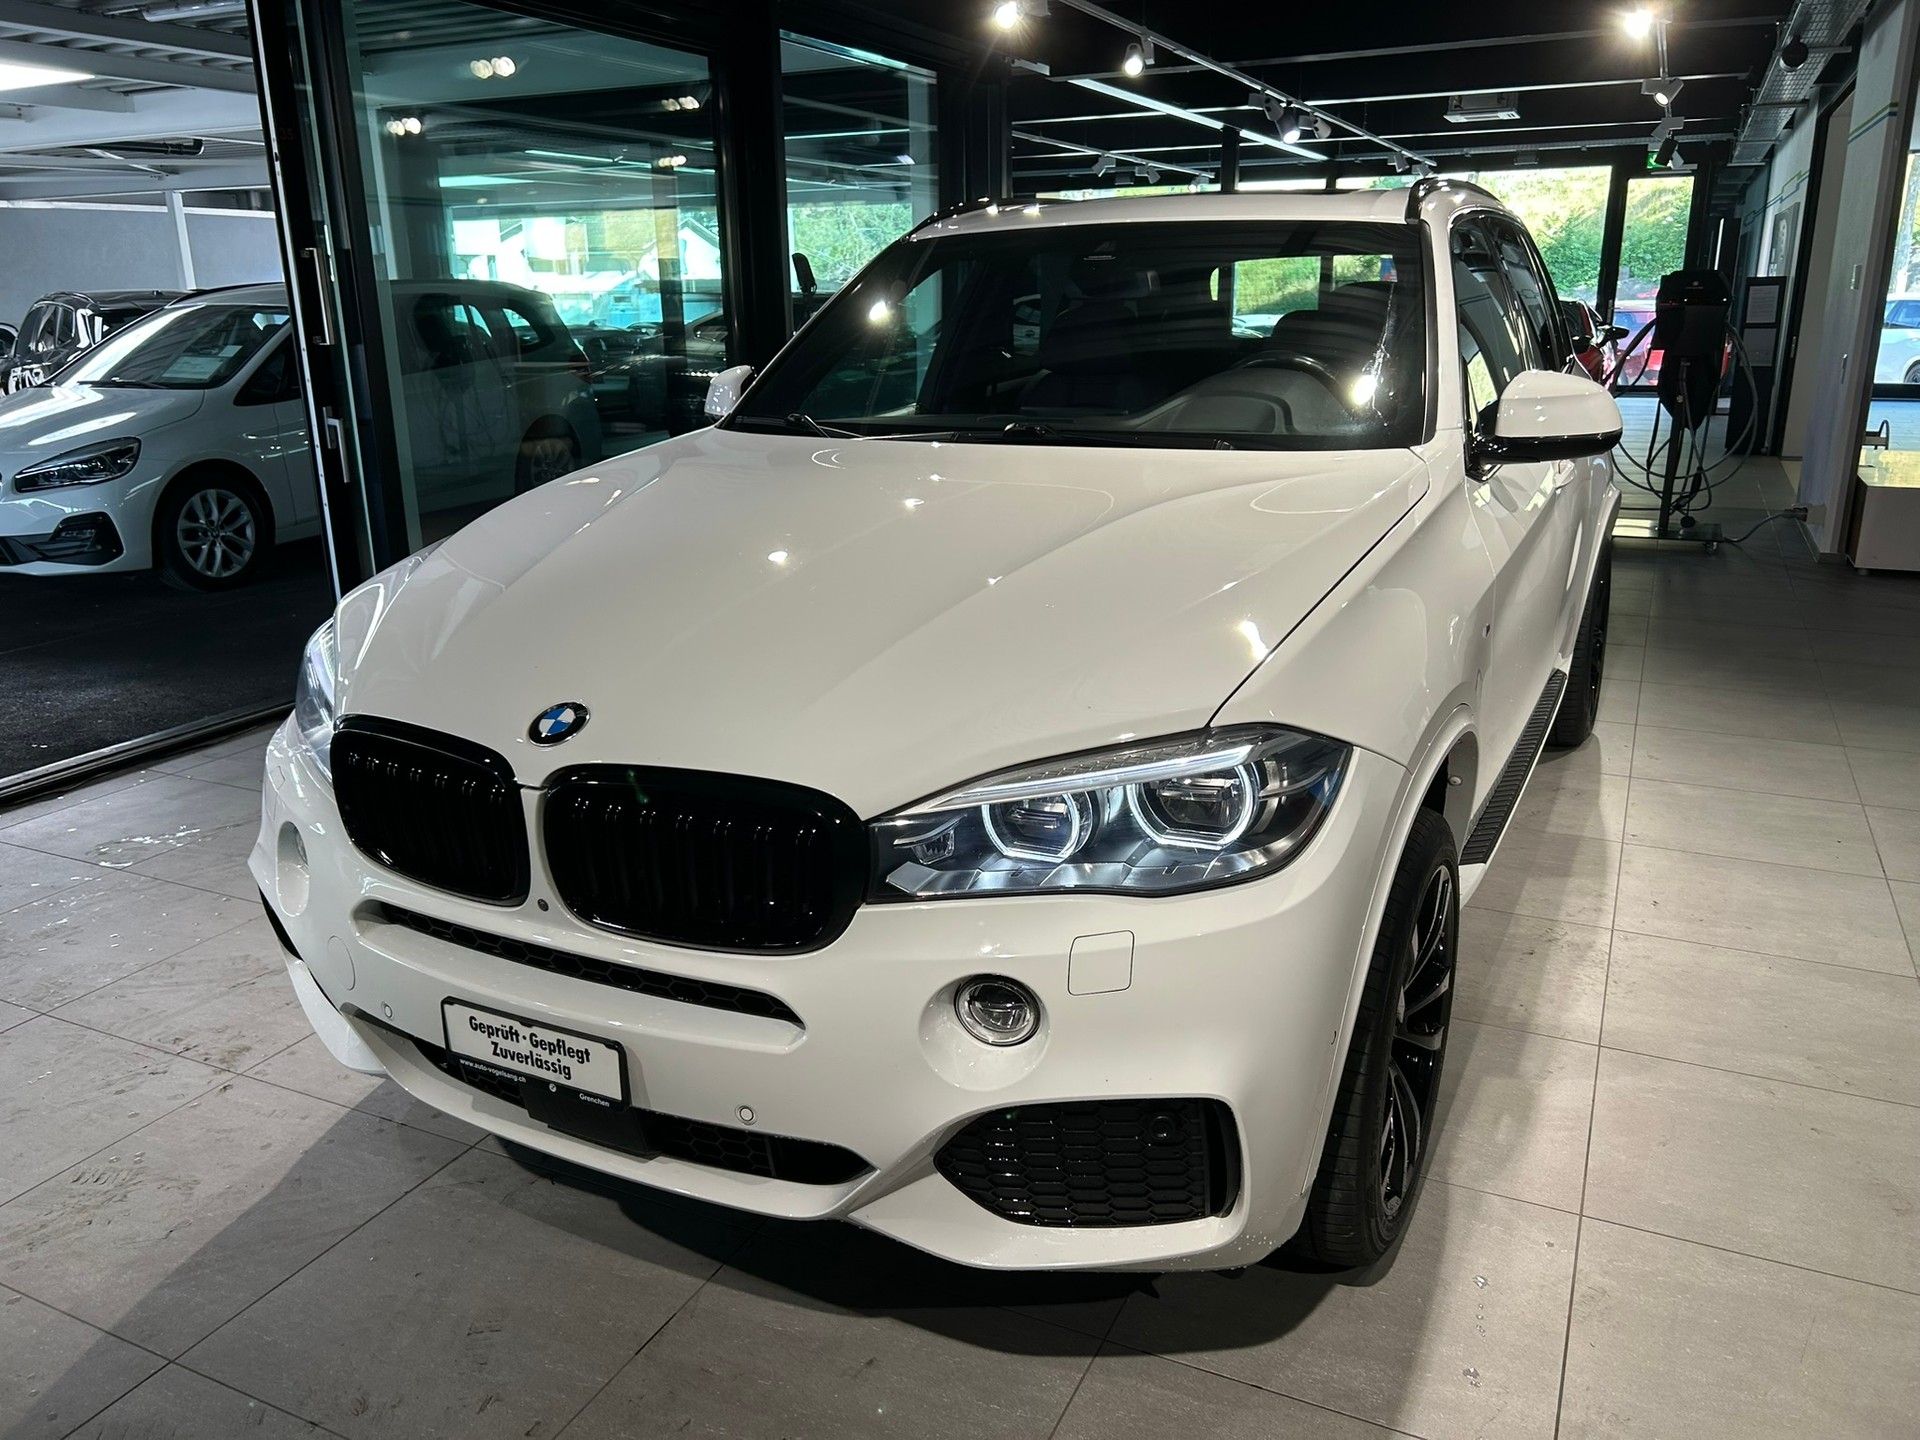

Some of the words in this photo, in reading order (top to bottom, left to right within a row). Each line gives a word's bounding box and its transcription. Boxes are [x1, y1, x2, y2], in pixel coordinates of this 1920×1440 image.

[469, 1015, 520, 1043] Geprüft
[529, 1032, 591, 1065] Gepflegt
[459, 1058, 527, 1083] www.auto-vogelsang.ch
[491, 1041, 572, 1081] Zuverlässig
[579, 1092, 610, 1107] Grenchen
